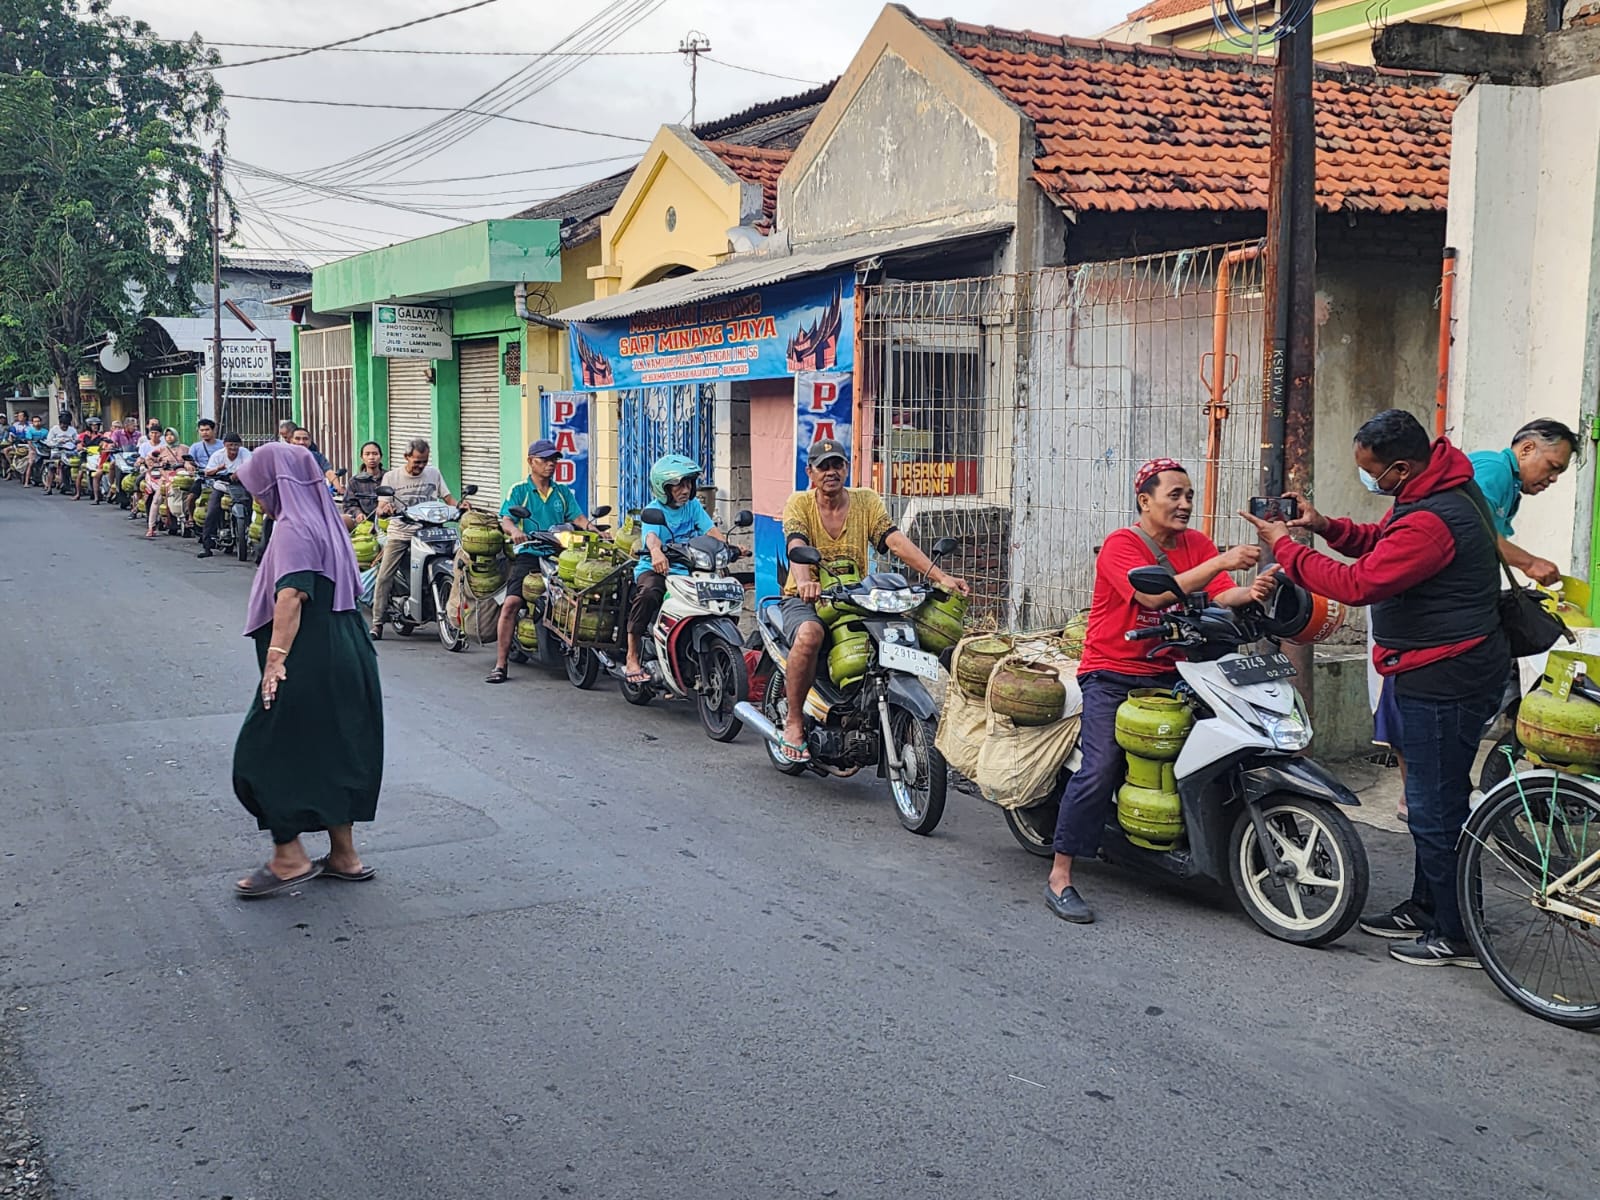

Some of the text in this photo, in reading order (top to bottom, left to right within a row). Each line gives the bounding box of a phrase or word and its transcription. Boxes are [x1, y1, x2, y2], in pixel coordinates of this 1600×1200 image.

[398, 307, 436, 320] GALAXY
[700, 295, 761, 321] PADANG
[620, 316, 777, 356] SARI MINANG JAYA
[241, 345, 267, 354] DOKTER
[896, 479, 949, 494] PADANG
[883, 644, 888, 653] L
[1219, 653, 1289, 674] L 5749 KO
